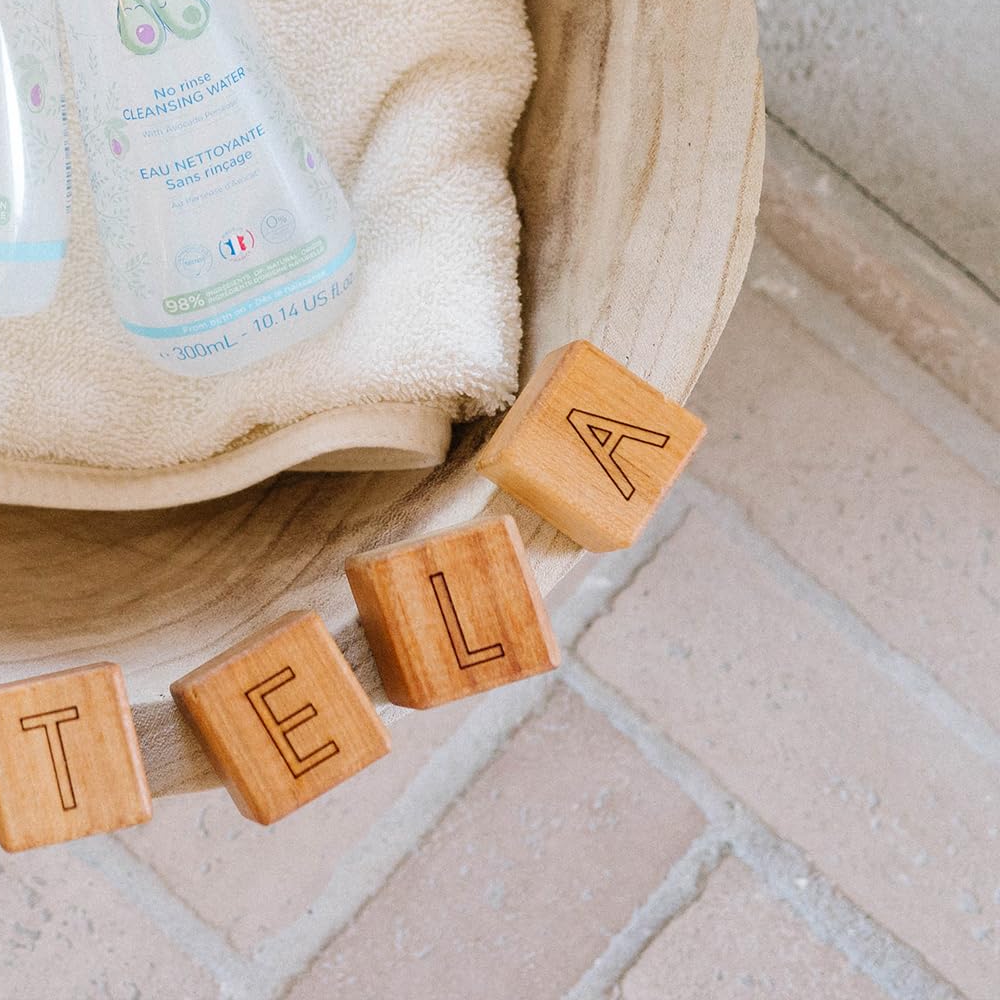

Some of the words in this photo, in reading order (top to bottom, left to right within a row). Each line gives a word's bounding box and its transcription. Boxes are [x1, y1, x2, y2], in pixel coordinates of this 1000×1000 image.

[122, 90, 204, 121] CLEANSING
[206, 66, 246, 97] WATER
[153, 86, 176, 101] No
[180, 73, 212, 92] rinse
[139, 164, 170, 180] EAU
[174, 123, 266, 172] NETTOYANTE
[166, 172, 201, 191] Sans
[204, 150, 253, 179] rinçage
[166, 294, 205, 313] 98%
[173, 334, 238, 361] 300mL
[253, 303, 299, 332] 10.14
[303, 290, 329, 313] US
